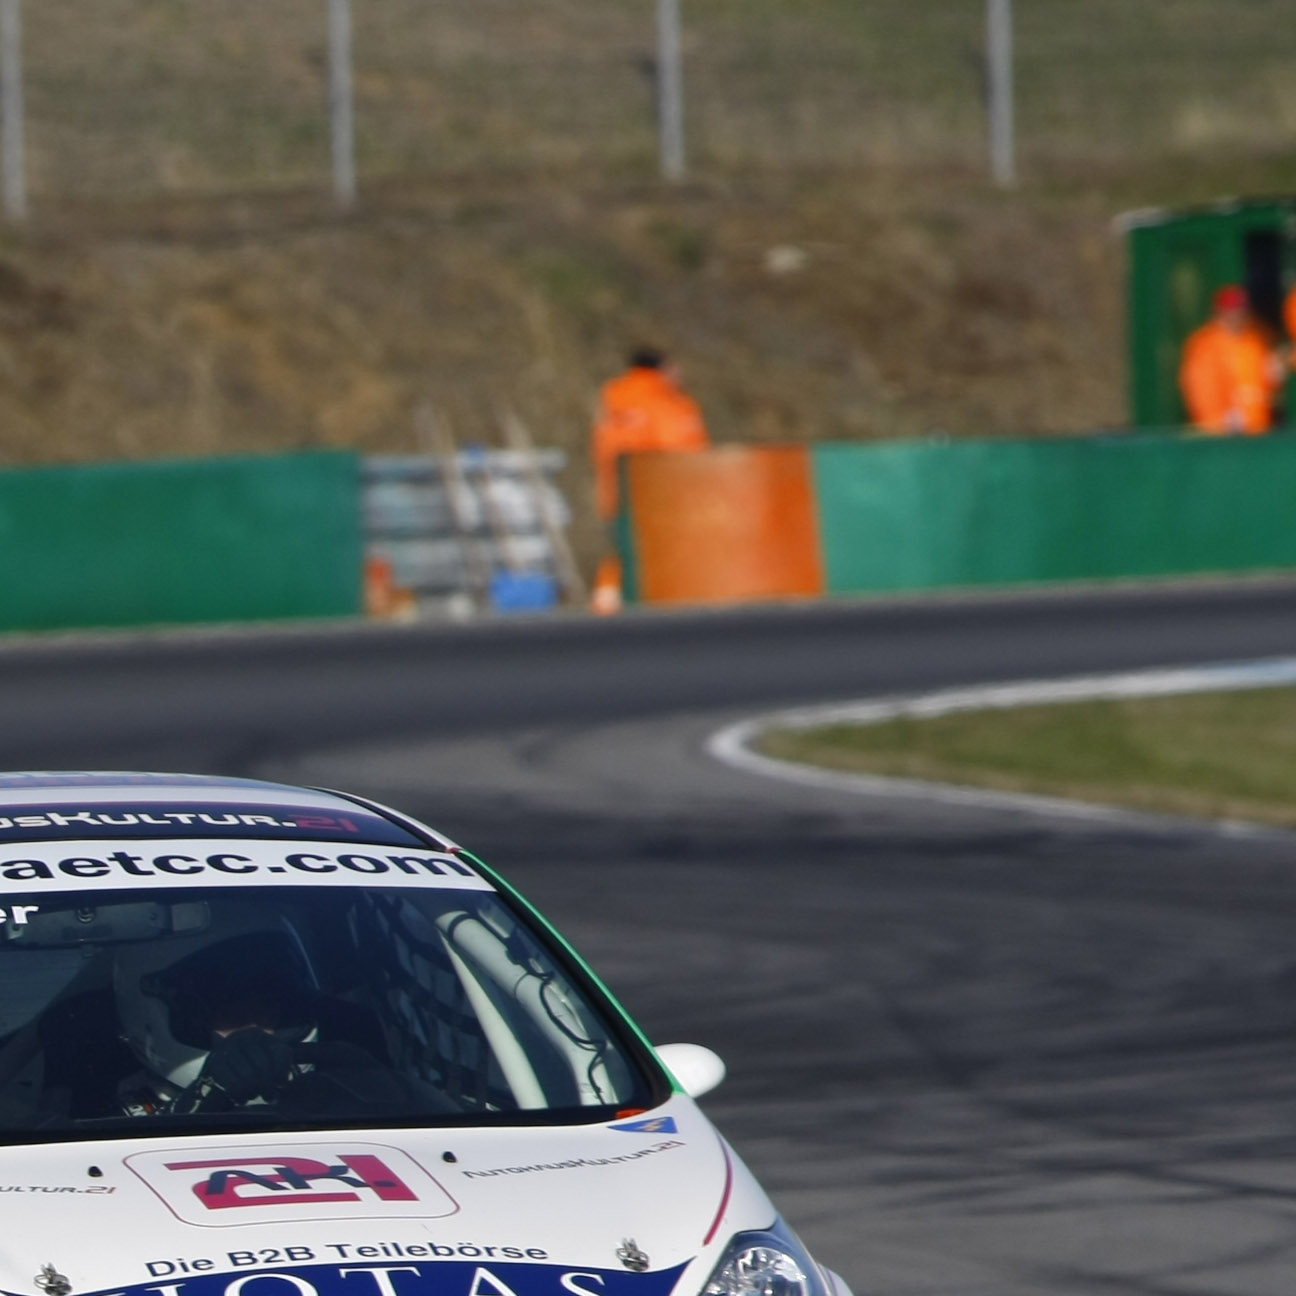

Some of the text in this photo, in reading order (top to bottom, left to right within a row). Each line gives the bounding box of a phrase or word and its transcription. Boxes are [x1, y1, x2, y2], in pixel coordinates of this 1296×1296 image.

[144, 1240, 548, 1277] Die B2B Teilebörse
